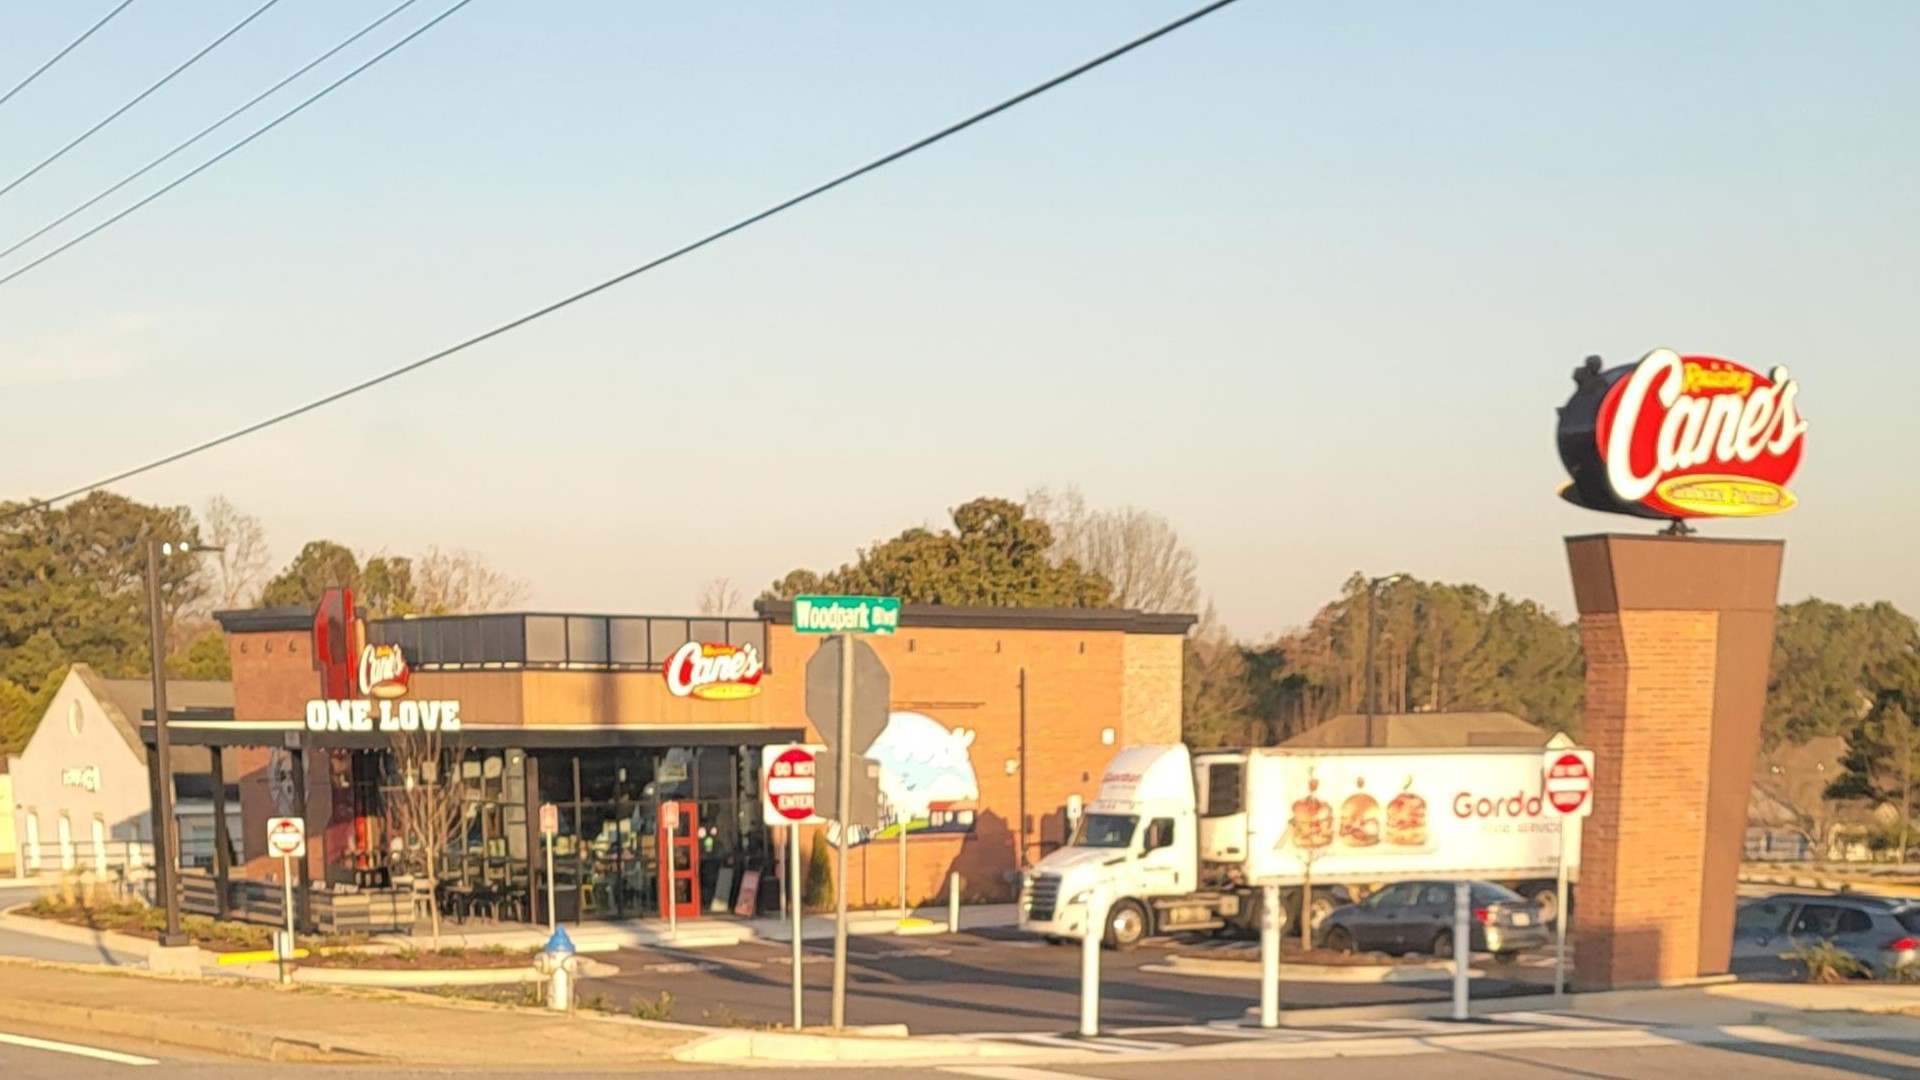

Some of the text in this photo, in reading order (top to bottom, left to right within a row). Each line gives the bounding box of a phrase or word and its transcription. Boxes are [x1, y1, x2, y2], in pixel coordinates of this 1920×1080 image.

[1607, 348, 1808, 500] Cane's
[796, 600, 870, 631] Woodpark
[667, 641, 763, 697] Cane's
[306, 700, 461, 731] ONE LOVE
[774, 761, 792, 777] DO
